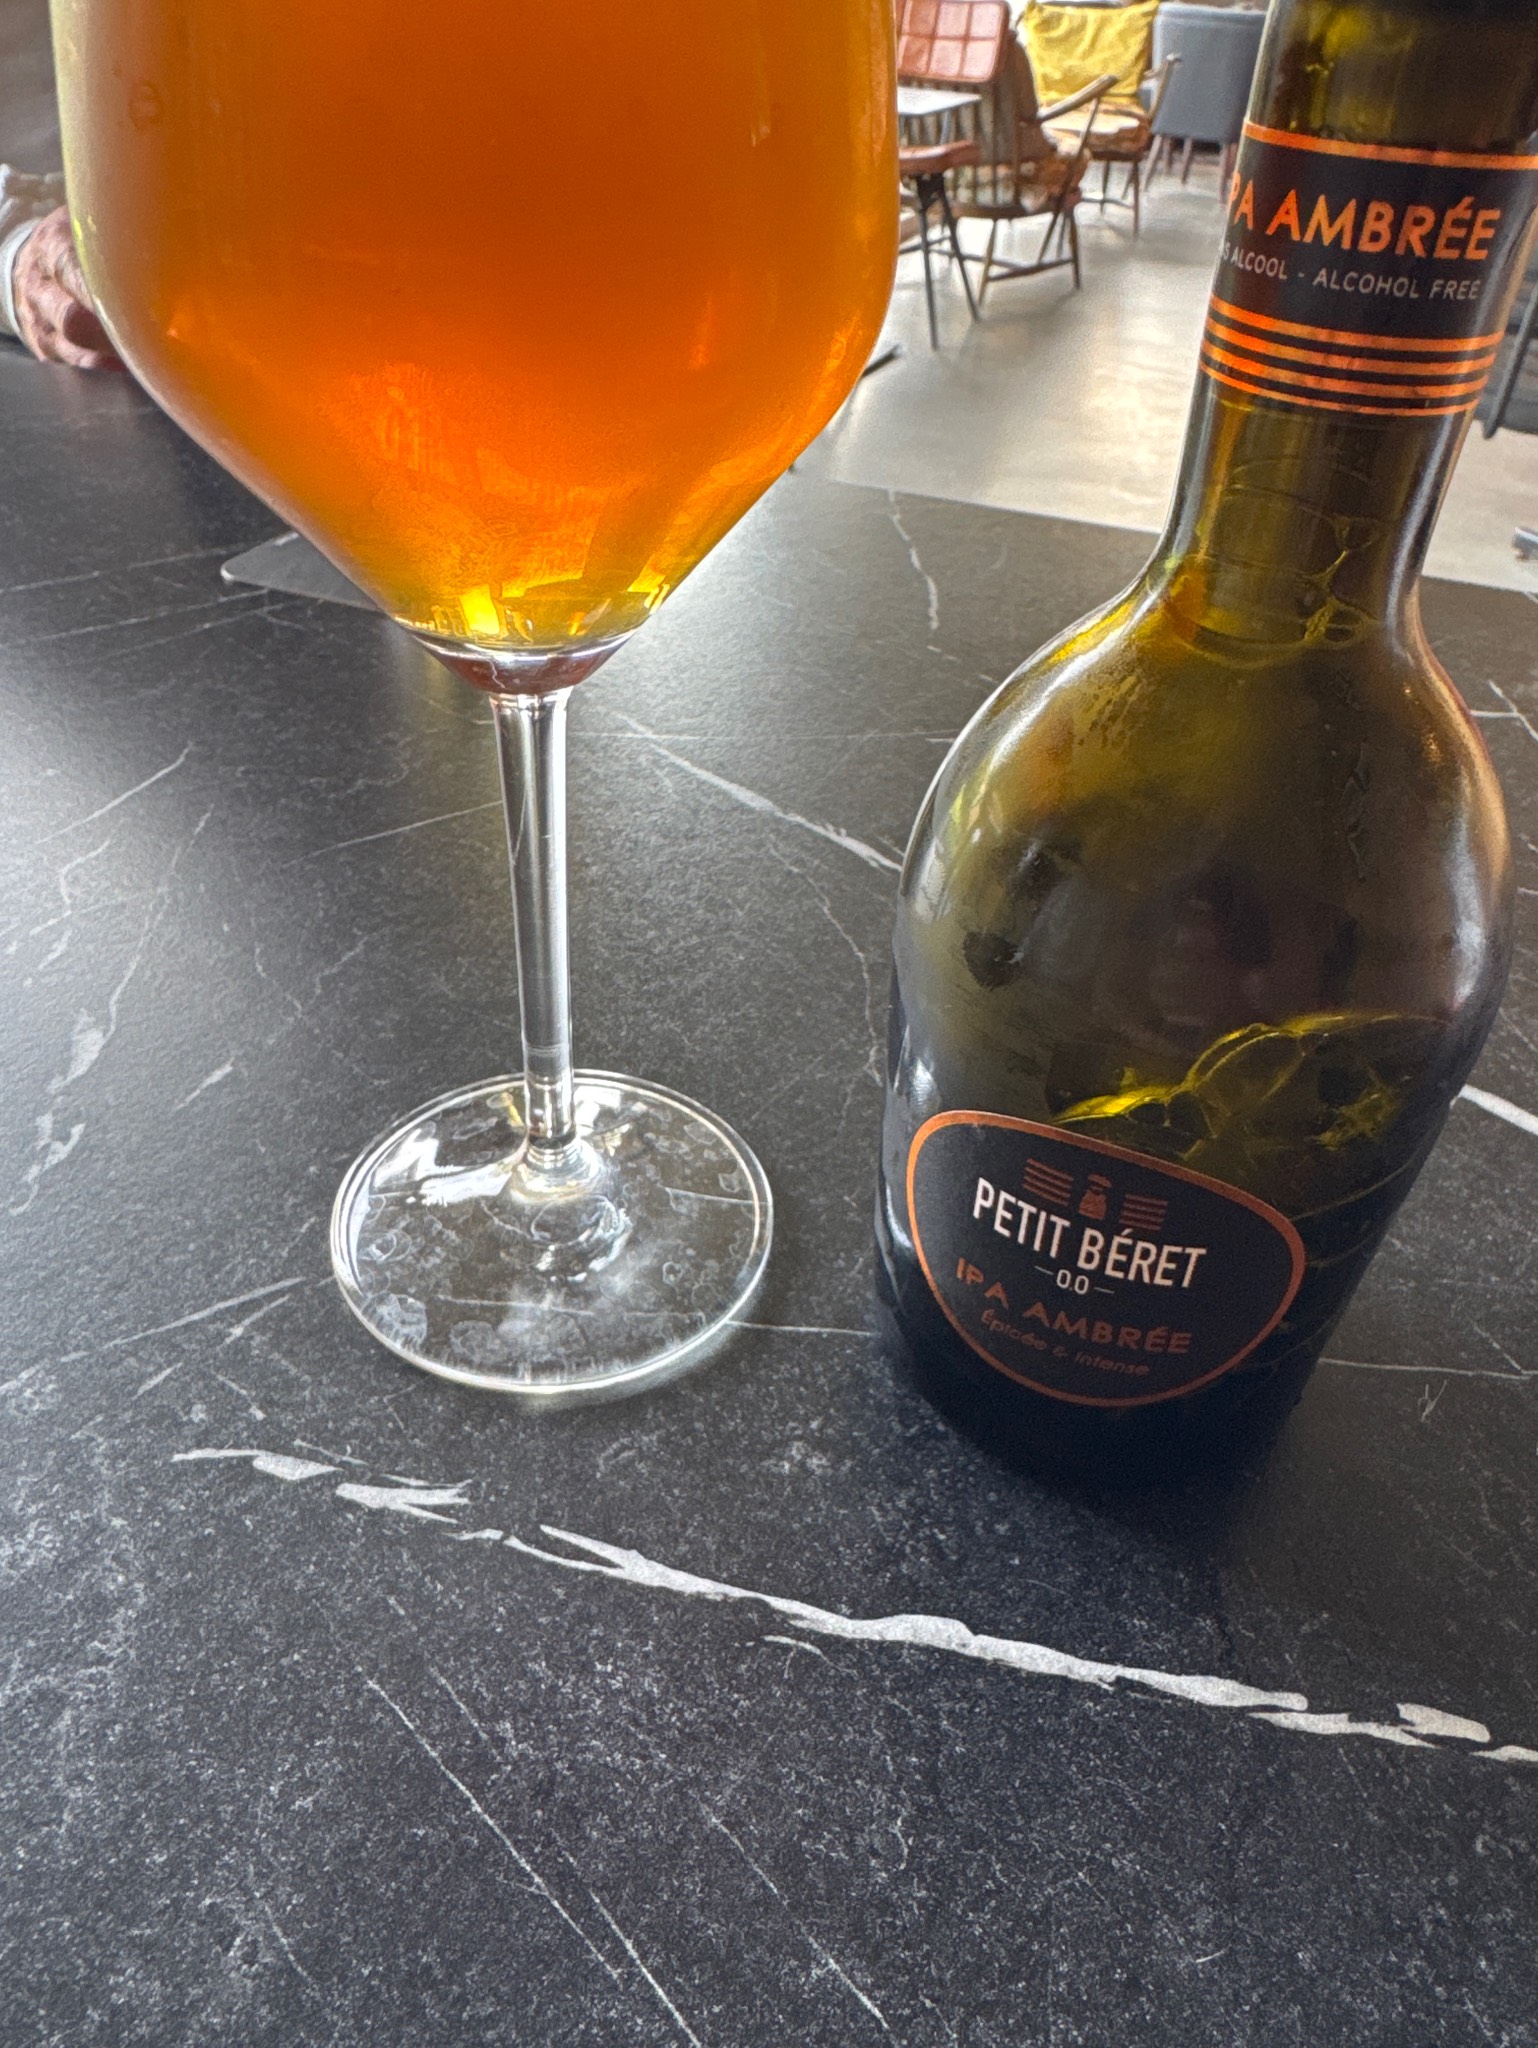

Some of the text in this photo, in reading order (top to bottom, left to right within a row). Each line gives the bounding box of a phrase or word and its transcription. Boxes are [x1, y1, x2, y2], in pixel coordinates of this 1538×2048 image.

[1227, 170, 1501, 261] PA AMBRÉE
[1230, 246, 1288, 280] ALCOOL
[1312, 268, 1420, 298] ALCOHOL
[1428, 279, 1482, 300] FREE
[973, 1177, 1207, 1288] PETIT BÉRET
[956, 1257, 1193, 1355] IPA AMBRÉE
[1052, 1345, 1069, 1358] &
